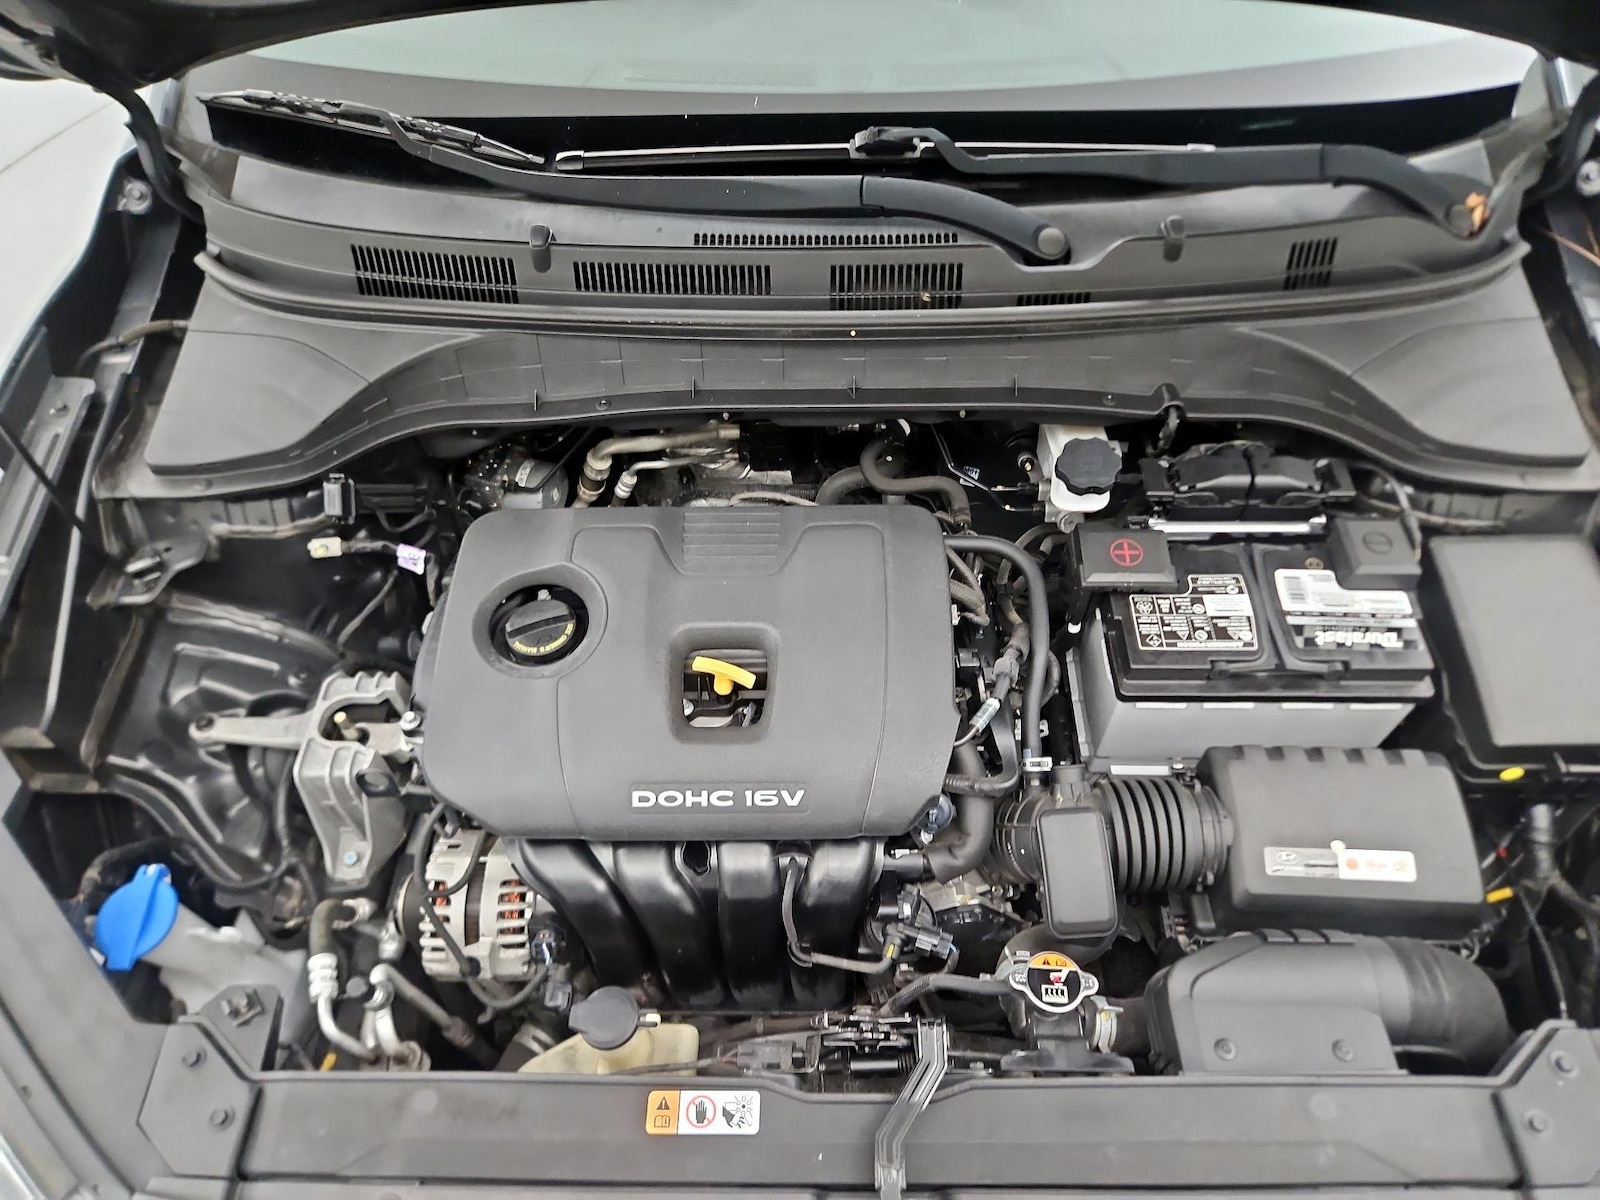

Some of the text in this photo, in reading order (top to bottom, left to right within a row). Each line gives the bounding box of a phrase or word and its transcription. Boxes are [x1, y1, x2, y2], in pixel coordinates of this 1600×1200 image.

[513, 641, 537, 653] MANUAL
[1314, 631, 1402, 648] Duralast
[631, 789, 805, 808] DOHC 16V
